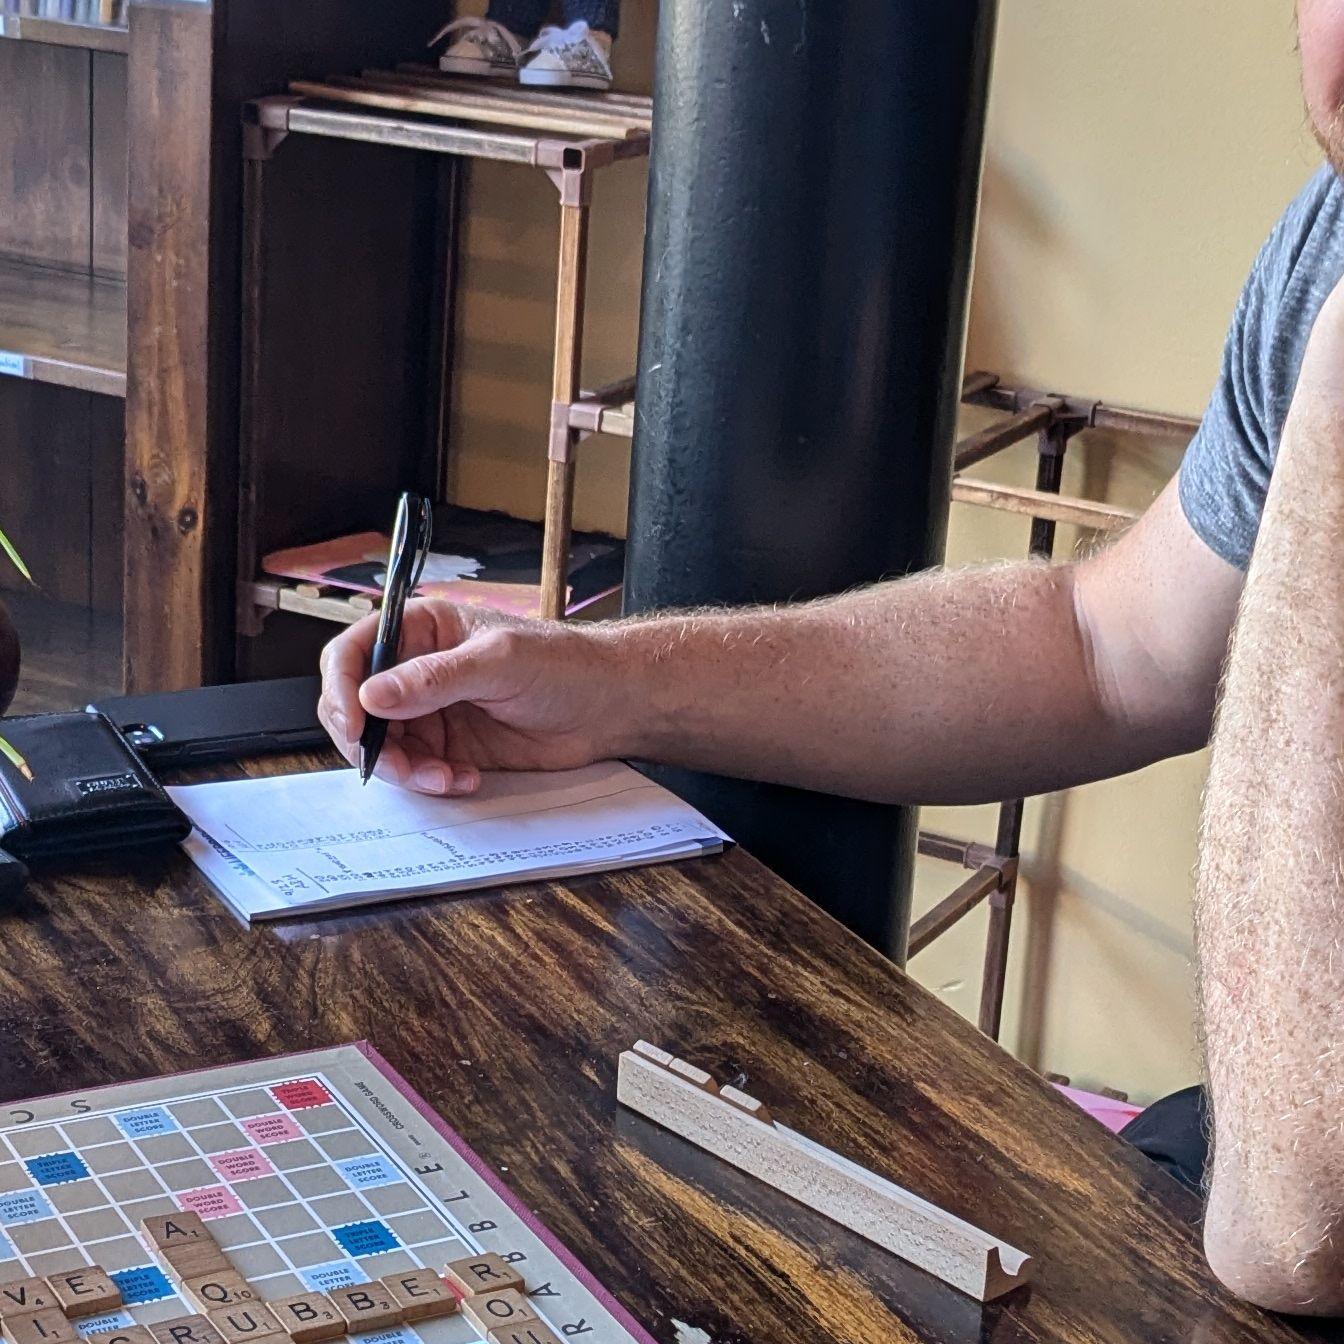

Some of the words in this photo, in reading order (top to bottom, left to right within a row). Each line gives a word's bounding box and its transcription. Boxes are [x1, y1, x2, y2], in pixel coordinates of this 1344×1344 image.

[122, 1112, 159, 1122] DOUBLE
[129, 1118, 160, 1127] LETTER
[133, 1123, 165, 1132] SCORE
[246, 1118, 283, 1128] DOUBLE
[254, 1124, 285, 1133] WORD
[259, 1130, 291, 1138] SCORE
[217, 1154, 254, 1164] DOUBLE
[224, 1160, 256, 1169] WORD
[344, 1161, 381, 1171] DOUBLE
[230, 1165, 262, 1175] SCORE
[351, 1167, 383, 1177] LETTER
[357, 1173, 389, 1182] SCORE
[362, 1331, 403, 1344] DOUBLE
